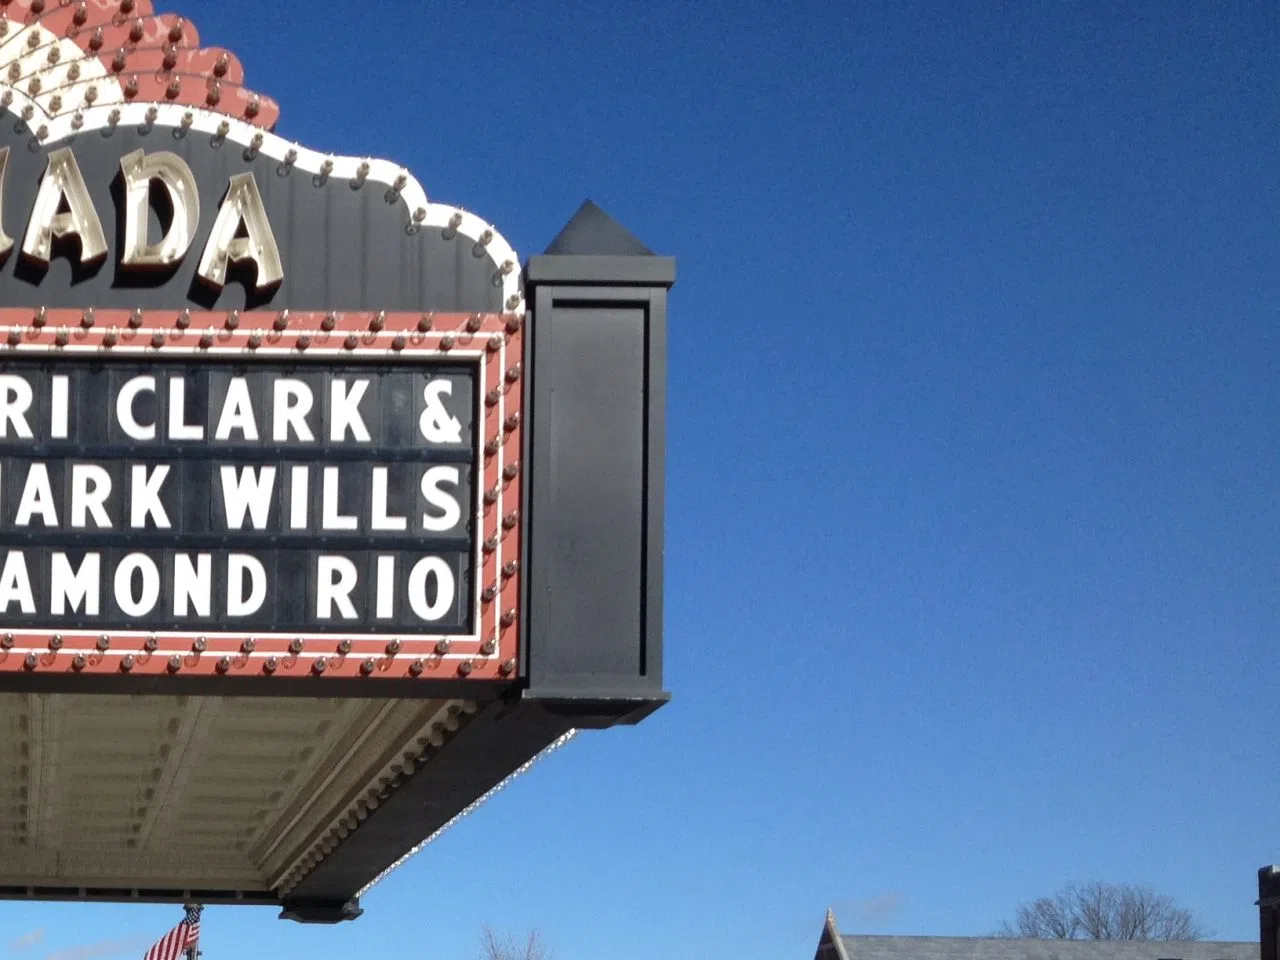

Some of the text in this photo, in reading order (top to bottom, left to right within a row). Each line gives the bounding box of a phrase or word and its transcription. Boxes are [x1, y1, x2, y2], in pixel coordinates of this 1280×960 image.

[116, 376, 372, 443] CLARK
[418, 378, 462, 444] &
[220, 465, 461, 532] WILLS
[316, 555, 455, 621] RIO
